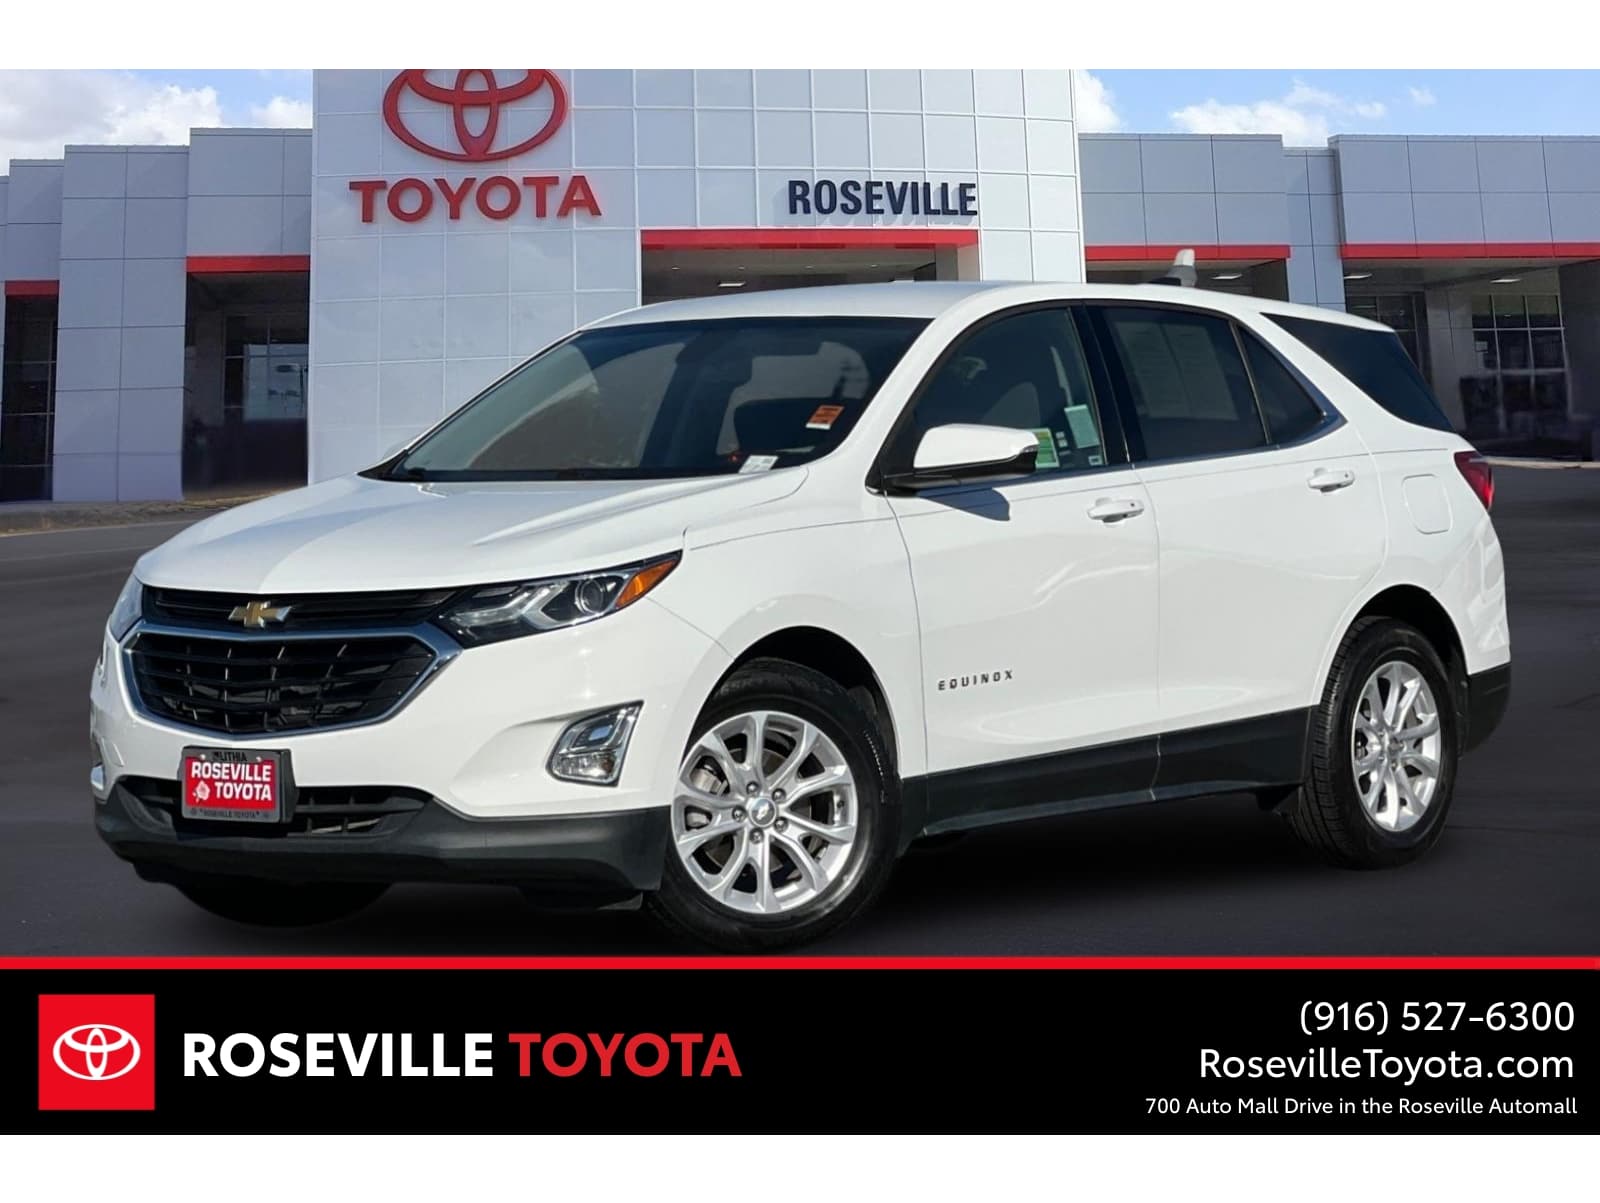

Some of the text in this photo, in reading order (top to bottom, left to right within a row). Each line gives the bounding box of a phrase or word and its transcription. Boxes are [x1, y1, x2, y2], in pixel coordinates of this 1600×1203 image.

[349, 175, 602, 223] TOYOTA
[788, 180, 978, 216] ROSEVILLE
[938, 670, 1013, 691] EQUINOX
[191, 762, 272, 782] ROSEVILLE
[214, 781, 272, 801] TOYOTA
